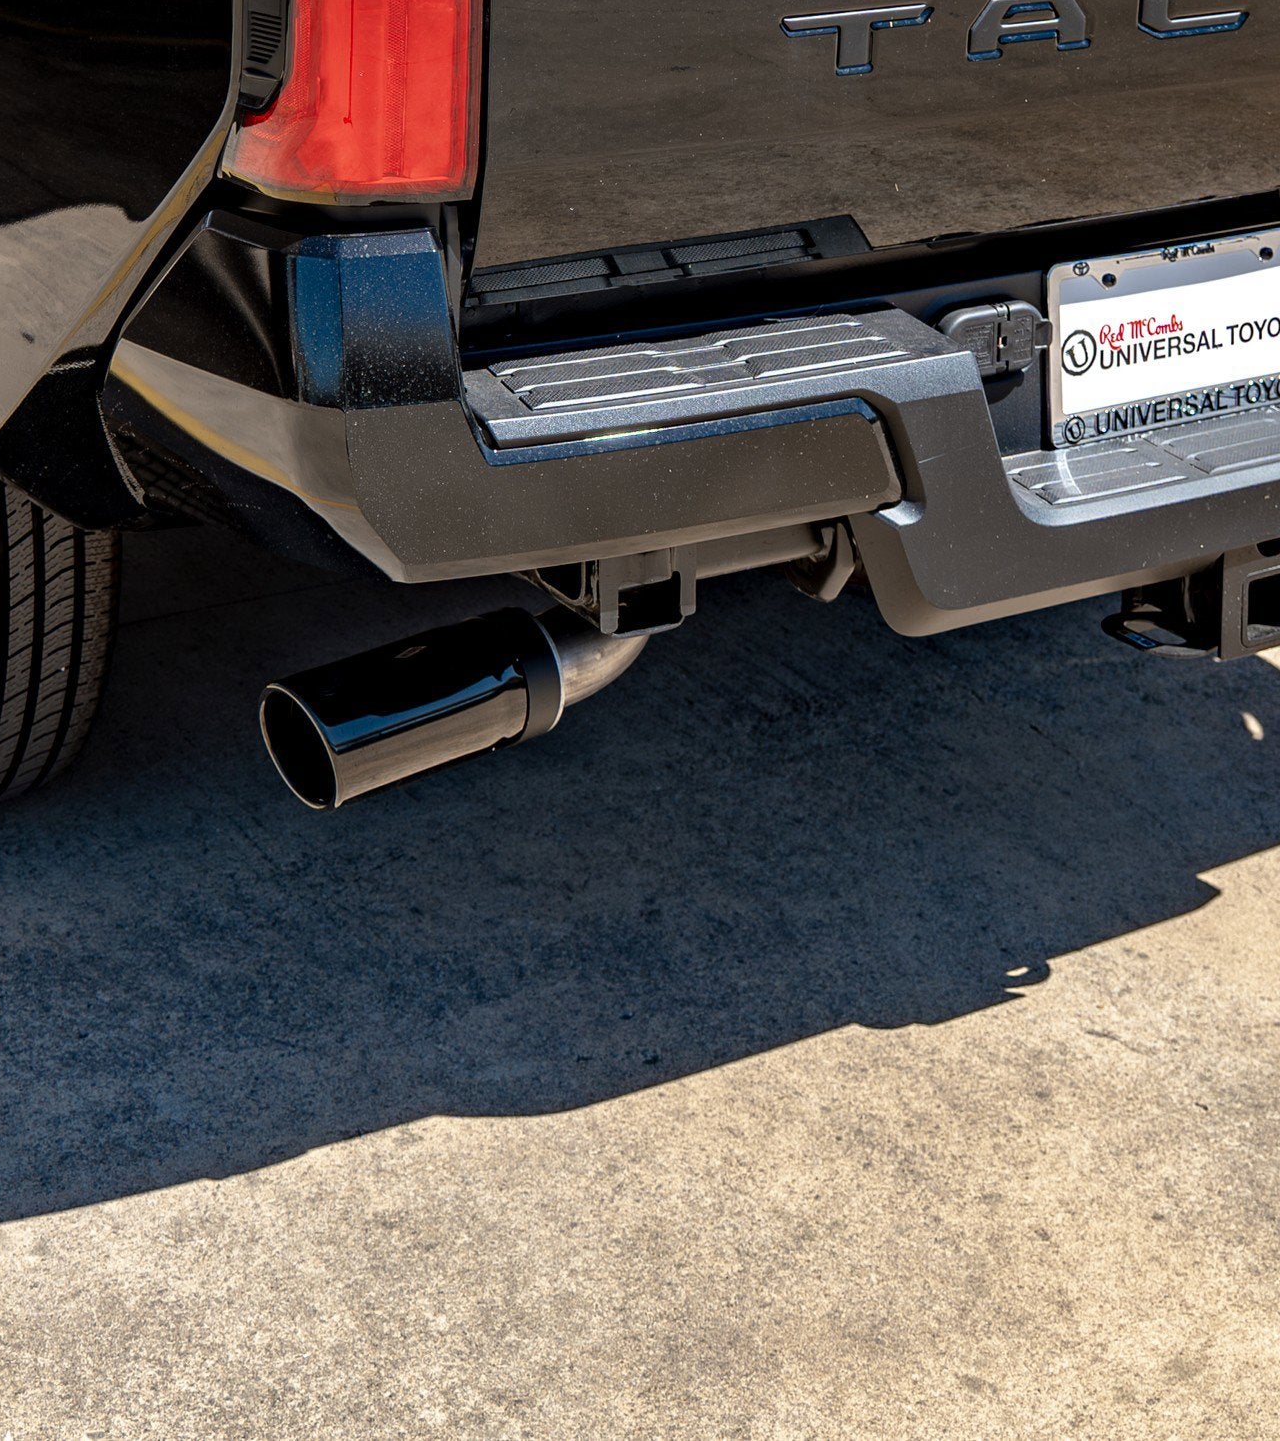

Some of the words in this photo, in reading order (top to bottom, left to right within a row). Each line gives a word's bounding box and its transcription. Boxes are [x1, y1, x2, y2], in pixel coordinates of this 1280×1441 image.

[1099, 324, 1124, 350] Red
[1127, 314, 1183, 340] McCombs
[1100, 329, 1223, 370] UNIVERSAL
[1096, 390, 1227, 435] UNIVERSAL
